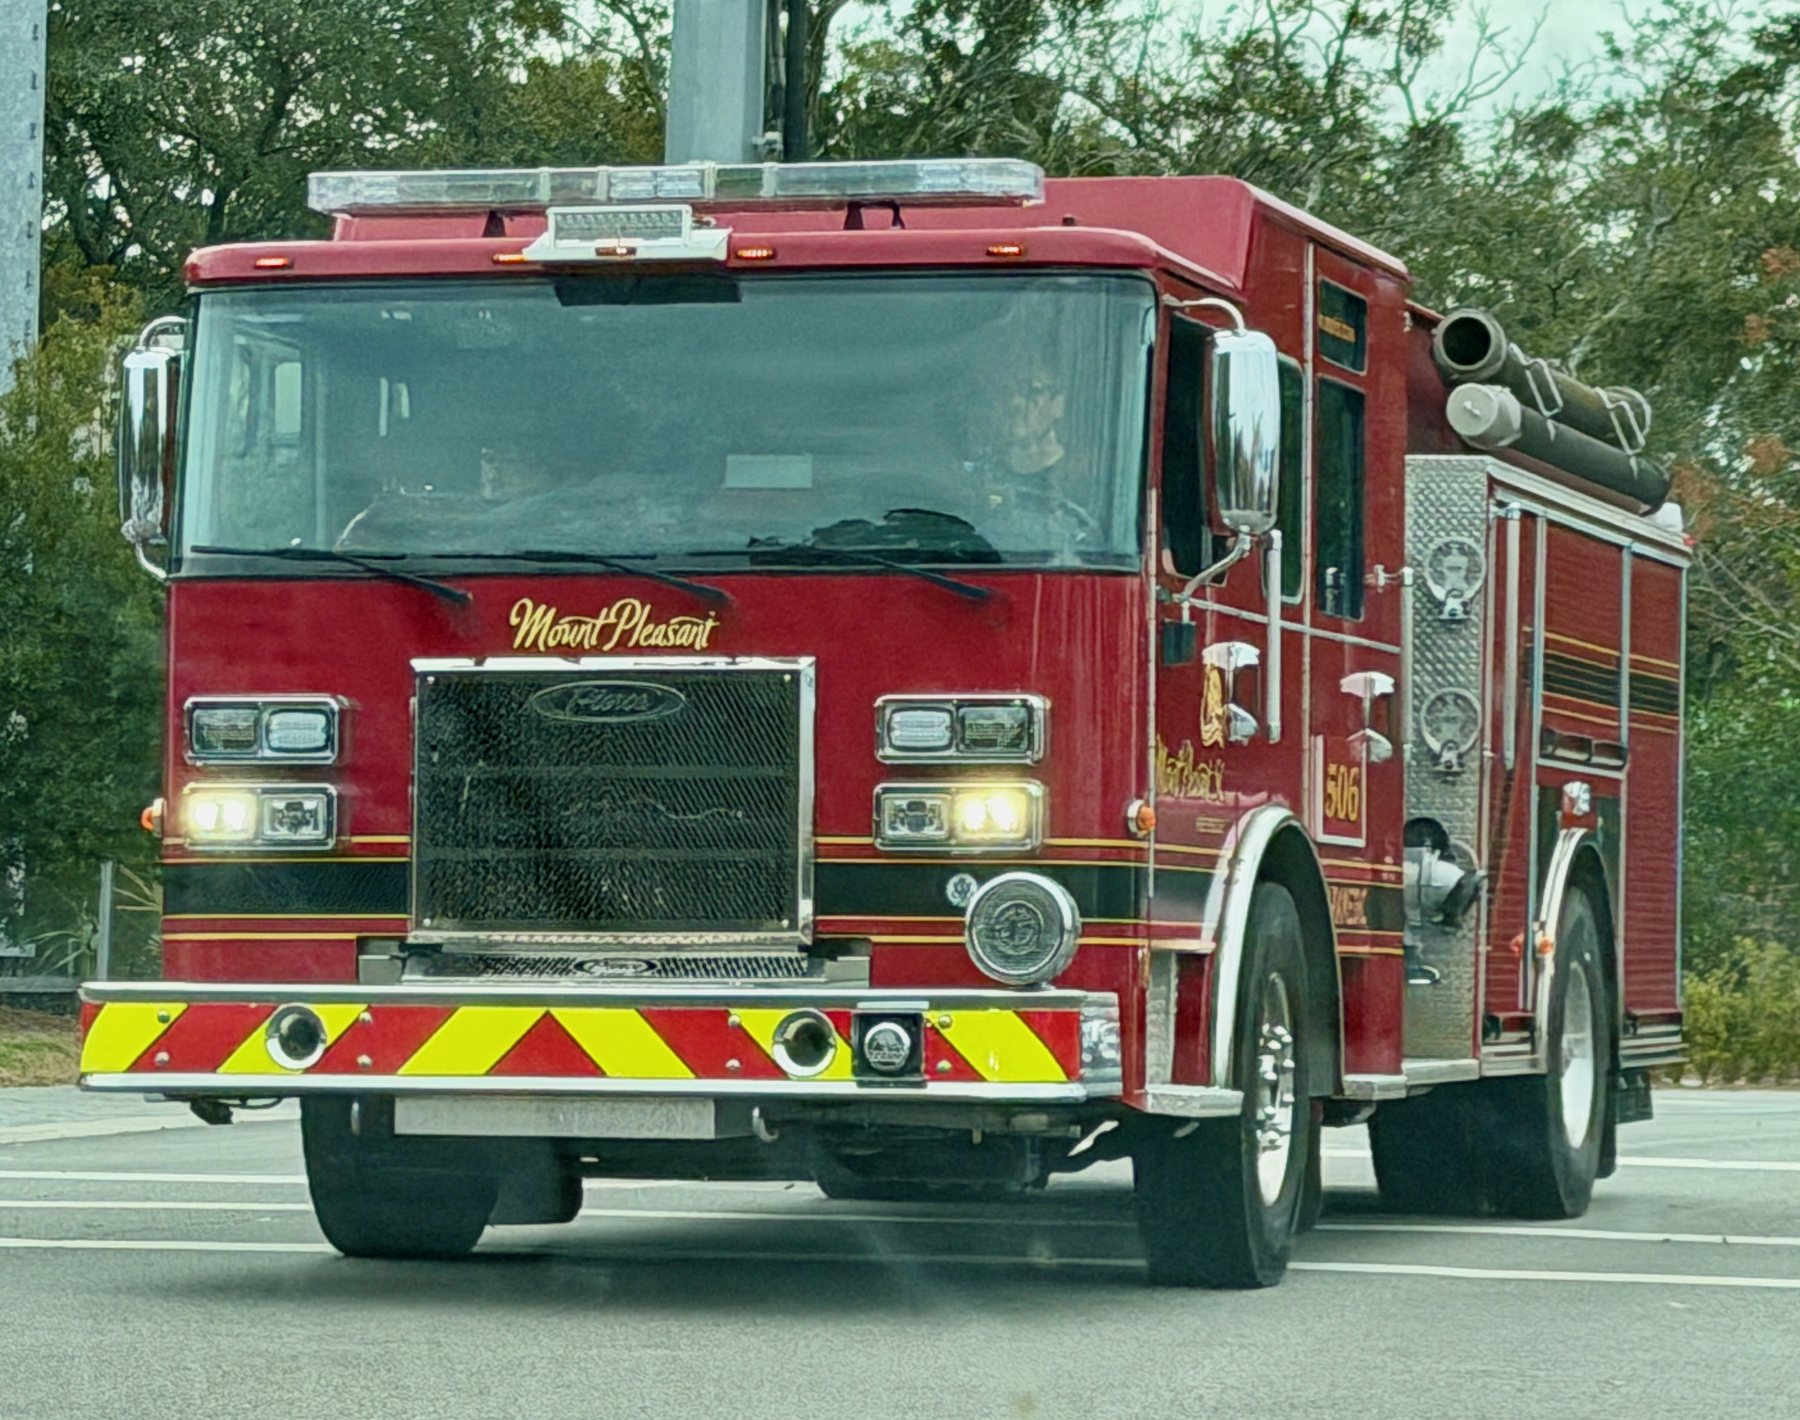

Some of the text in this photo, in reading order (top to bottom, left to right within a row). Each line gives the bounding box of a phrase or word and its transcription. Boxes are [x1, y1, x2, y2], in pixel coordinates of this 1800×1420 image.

[509, 597, 720, 652] Mount Pleasant
[1325, 763, 1360, 821] 506
